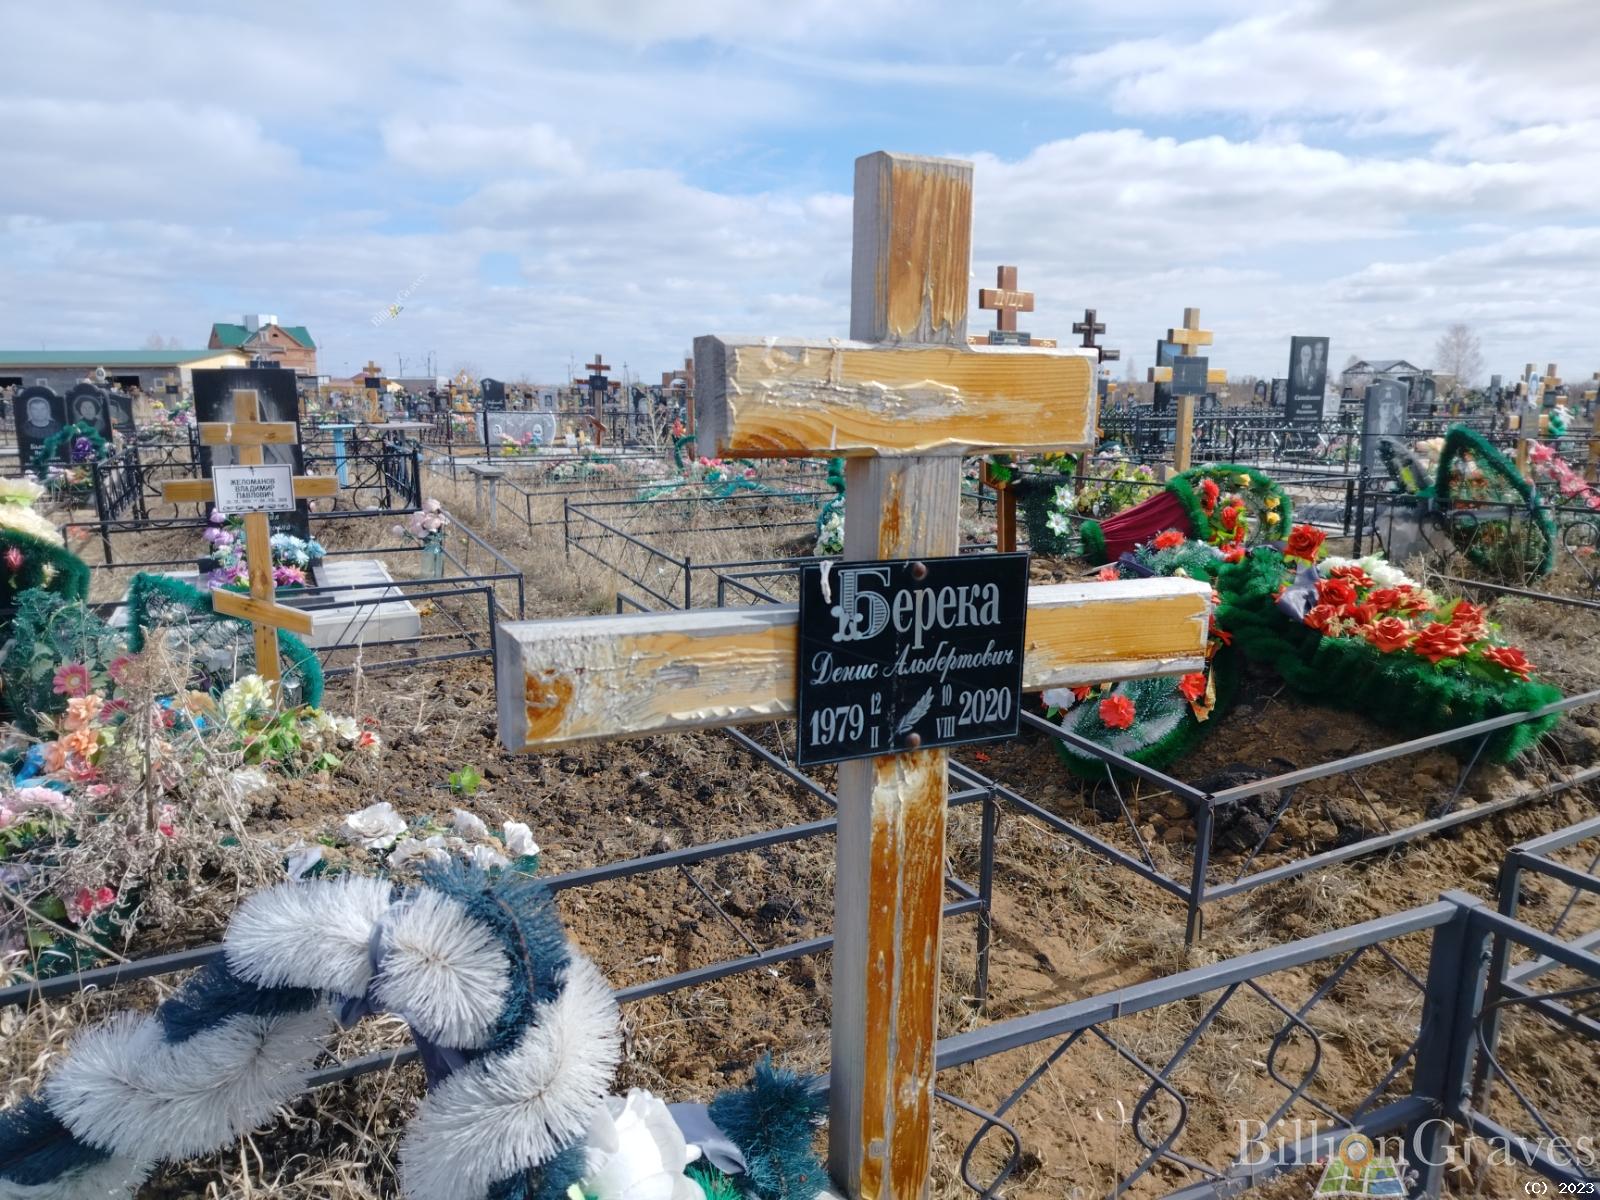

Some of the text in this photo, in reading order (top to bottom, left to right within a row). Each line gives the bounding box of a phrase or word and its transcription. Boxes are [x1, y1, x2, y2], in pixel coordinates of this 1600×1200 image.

[230, 478, 276, 486] ЖЕЛОМАНОВ
[234, 485, 275, 493] ВЛАДИМИР
[236, 491, 274, 499] ПАВЛОВИЧ
[830, 566, 1001, 650] Берека
[809, 639, 1014, 686] Денис Альбертович
[870, 692, 882, 715] 12
[941, 684, 952, 706] 10
[958, 686, 1012, 726] 2020
[809, 703, 865, 746] 1979
[936, 716, 956, 739] VIII
